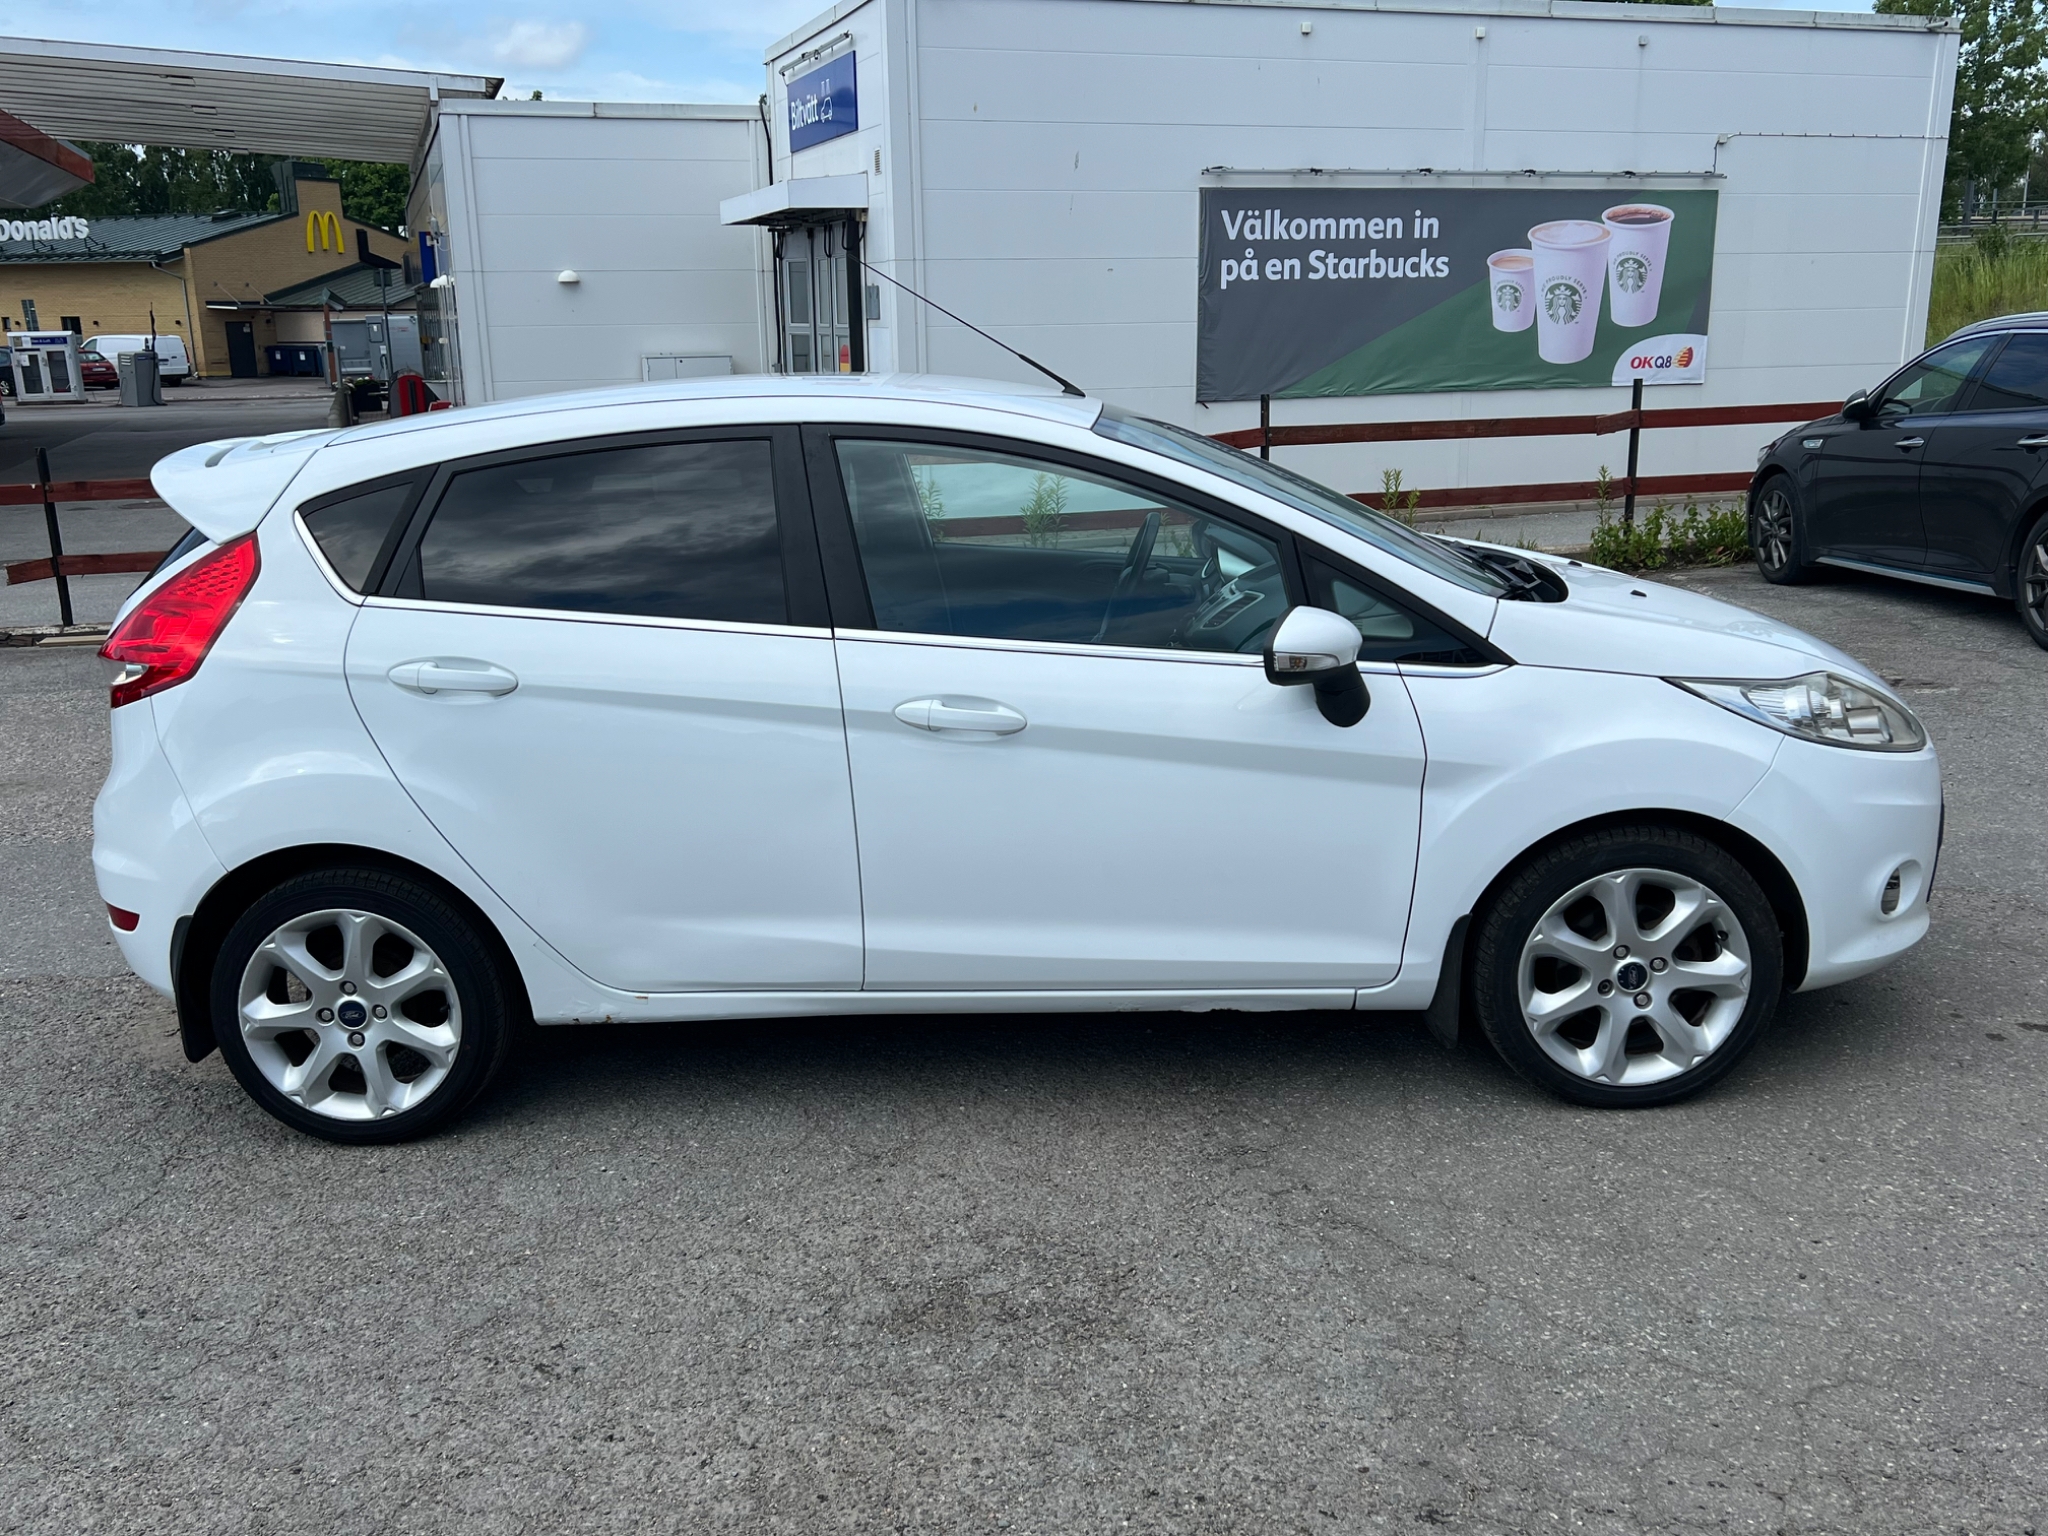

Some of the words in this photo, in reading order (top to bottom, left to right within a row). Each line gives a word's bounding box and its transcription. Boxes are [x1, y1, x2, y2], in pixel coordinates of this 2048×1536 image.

[1220, 209, 1404, 241] Välkommen
[1413, 209, 1440, 239] in
[1220, 248, 1259, 290] på
[1265, 257, 1301, 280] en
[1308, 248, 1450, 280] Starbucks
[1545, 275, 1572, 284] PROUDLY
[1573, 279, 1587, 294] SERVE
[1630, 355, 1672, 369] OKQ8
